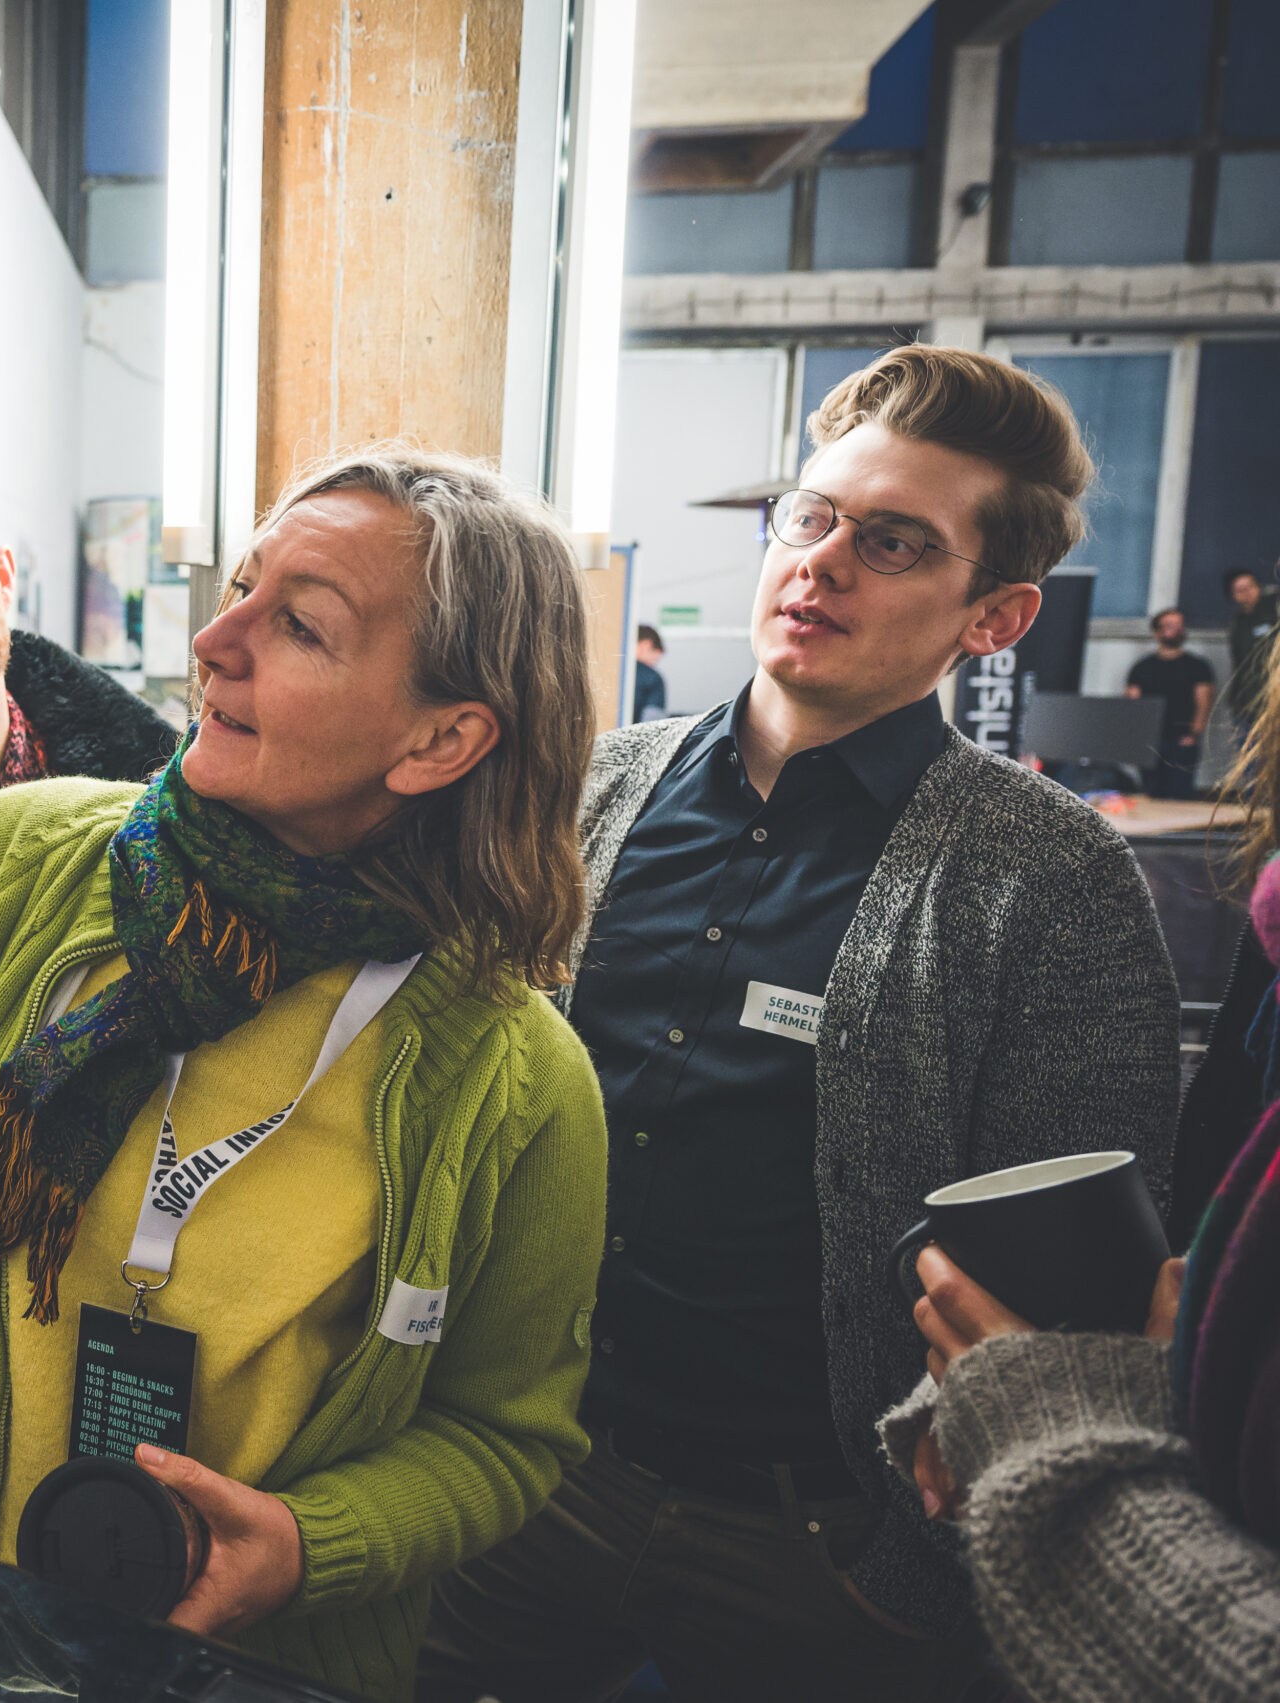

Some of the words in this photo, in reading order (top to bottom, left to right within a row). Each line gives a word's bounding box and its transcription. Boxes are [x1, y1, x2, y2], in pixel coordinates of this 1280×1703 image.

[152, 1148, 230, 1219] SOCIAL
[88, 1340, 114, 1355] AGENDA
[86, 1363, 105, 1375] 16:00
[113, 1370, 137, 1384] BEGINN
[140, 1378, 145, 1387] &
[147, 1380, 174, 1396] SNACKS
[86, 1375, 104, 1387] 16:30
[83, 1398, 102, 1410] 17:15
[109, 1405, 132, 1419] HAPPY
[133, 1412, 166, 1430] CREATING
[84, 1386, 103, 1399] 17:00
[110, 1393, 130, 1407] FINDE
[132, 1399, 152, 1413] DEINE
[154, 1406, 181, 1422] GRUPPE
[81, 1420, 100, 1433] 00:00
[82, 1409, 101, 1421] 19:00
[108, 1416, 129, 1431] PAUSE
[131, 1424, 136, 1433] &
[139, 1425, 158, 1440] PIZZA
[78, 1443, 98, 1456] 02:30
[80, 1431, 99, 1445] 02:00
[106, 1440, 134, 1456] PITCHES
